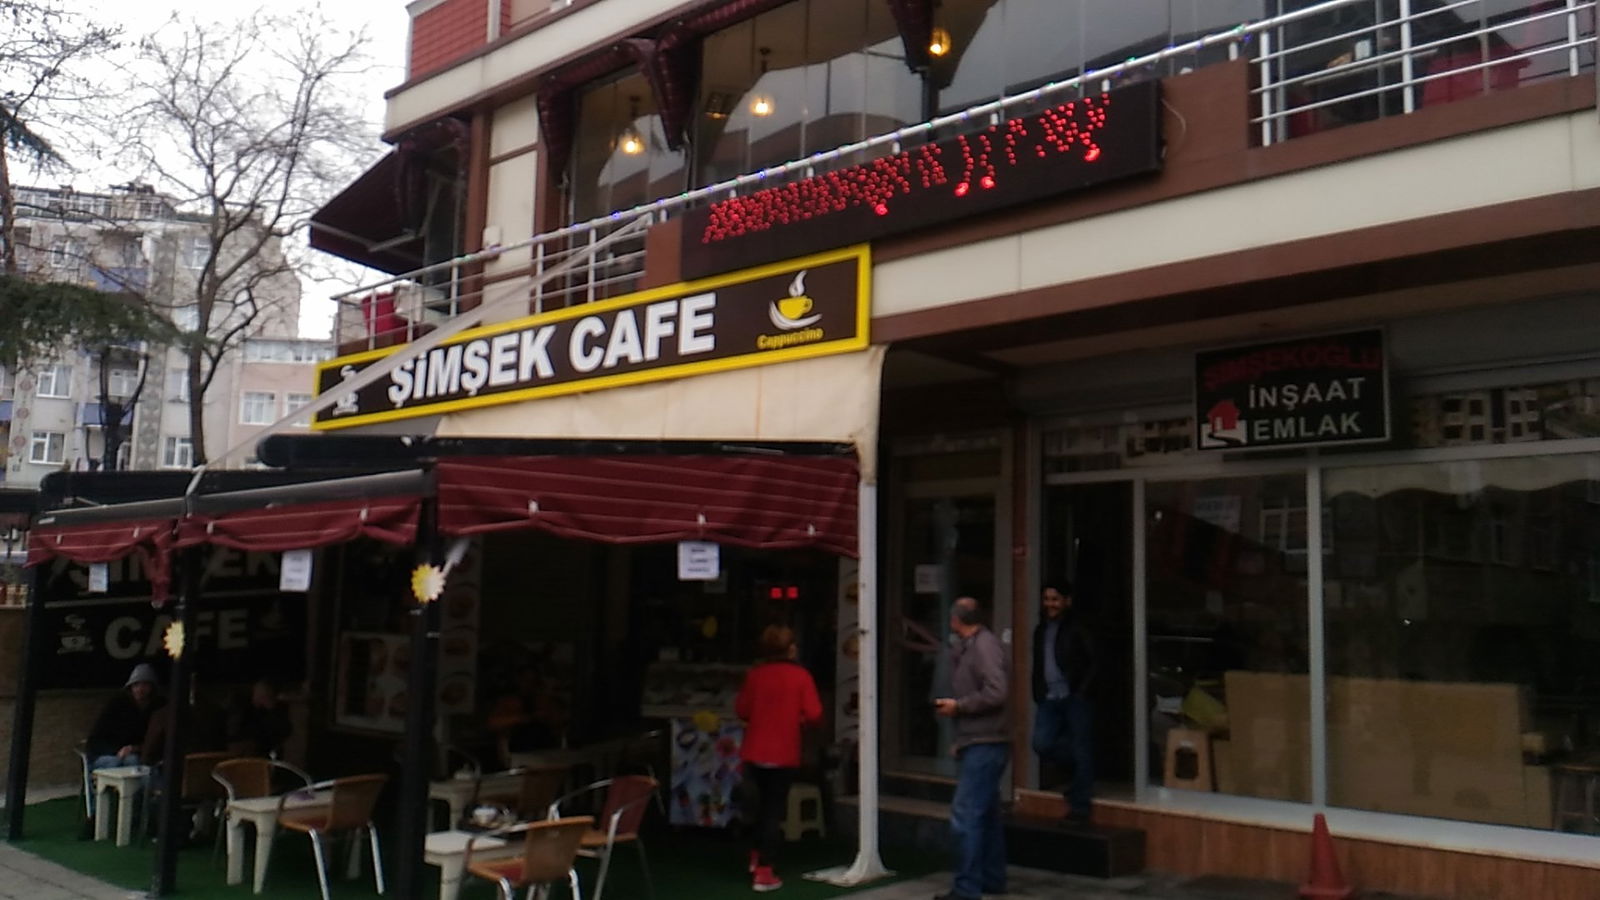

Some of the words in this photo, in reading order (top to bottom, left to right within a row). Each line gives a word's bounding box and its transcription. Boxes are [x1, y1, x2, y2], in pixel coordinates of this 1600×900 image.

[388, 325, 555, 408] ŞİMŞEK
[569, 292, 717, 373] CAFE
[757, 327, 824, 350] Cappuccino
[1249, 377, 1366, 410] İNŞAAT
[1253, 412, 1362, 441] EMLAK
